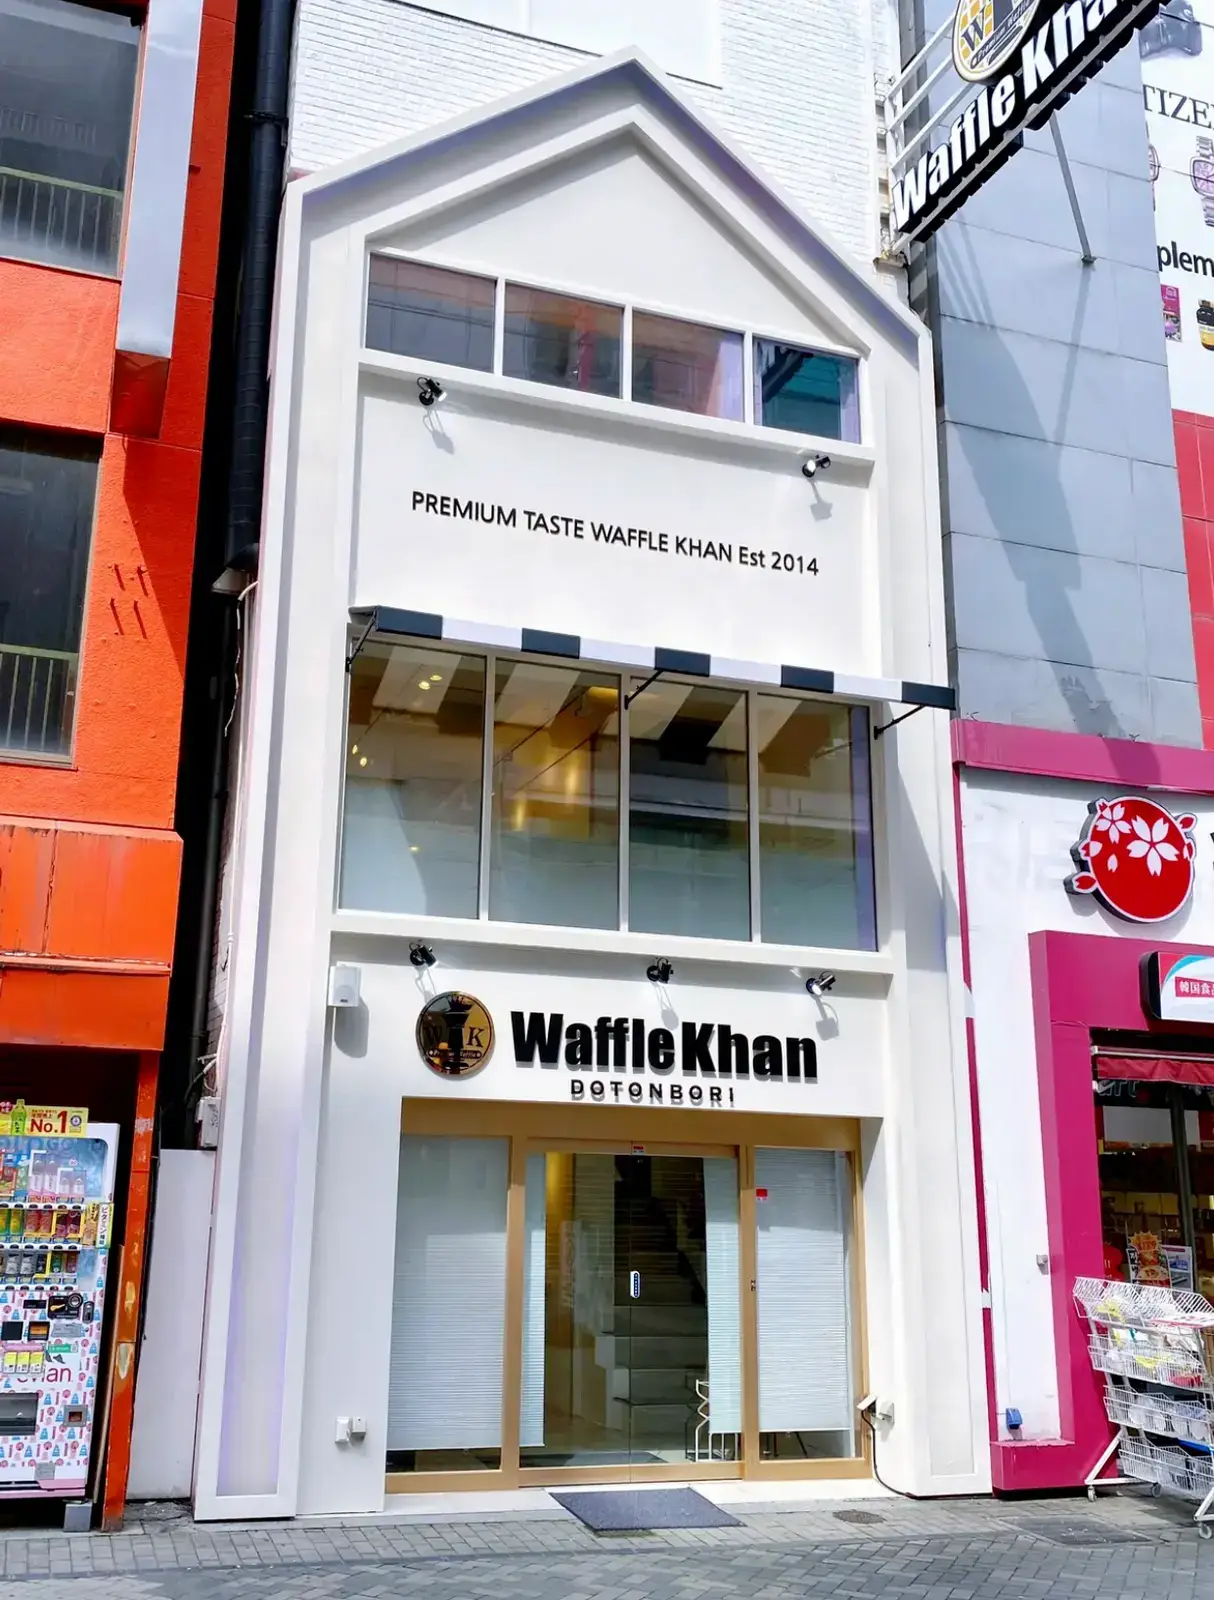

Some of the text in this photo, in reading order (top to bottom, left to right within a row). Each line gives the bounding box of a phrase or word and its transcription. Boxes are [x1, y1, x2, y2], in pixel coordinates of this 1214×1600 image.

[894, 73, 1016, 232] Waffle
[412, 491, 819, 576] PREMIUM TASTE WAFFLE KHAN Est 2014
[466, 1026, 485, 1048] K
[571, 1079, 735, 1103] DOTONBORI
[30, 1110, 68, 1133] No.1
